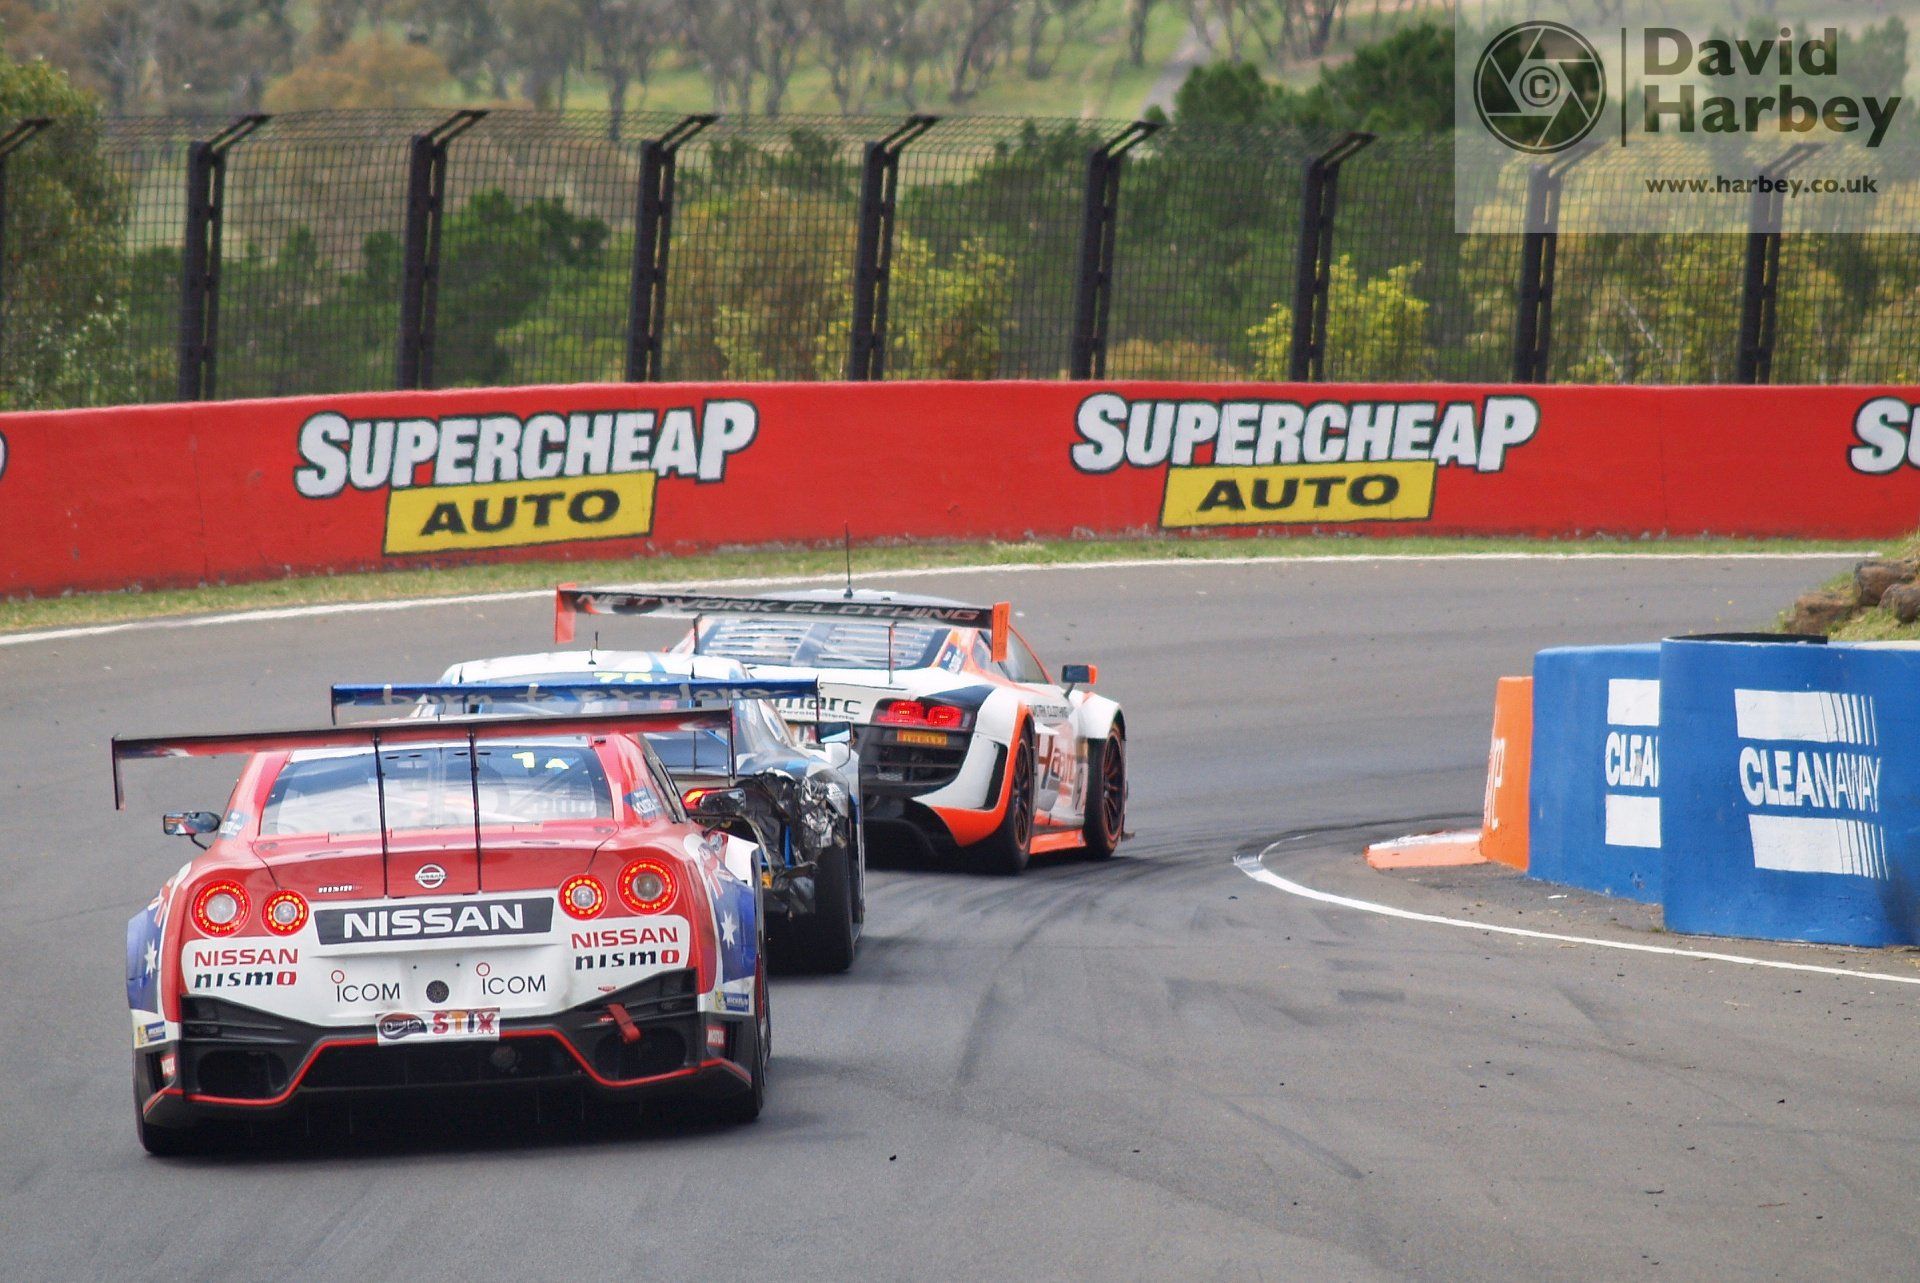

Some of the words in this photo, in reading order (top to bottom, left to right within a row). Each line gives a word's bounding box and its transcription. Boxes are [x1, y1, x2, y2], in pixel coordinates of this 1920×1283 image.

[294, 399, 759, 498] SUPERCHEAP
[1072, 393, 1539, 473] SUPERCHEAP
[1197, 475, 1400, 511] AUTO
[419, 488, 621, 537] AUTO
[785, 602, 980, 620] CLOTHING
[1739, 746, 1881, 813] CLEANAWAY
[344, 903, 524, 939] NISSAN
[571, 926, 678, 949] NISSAN
[194, 948, 298, 968] NISSAN
[575, 949, 680, 971] nismo
[194, 970, 297, 989] nismo
